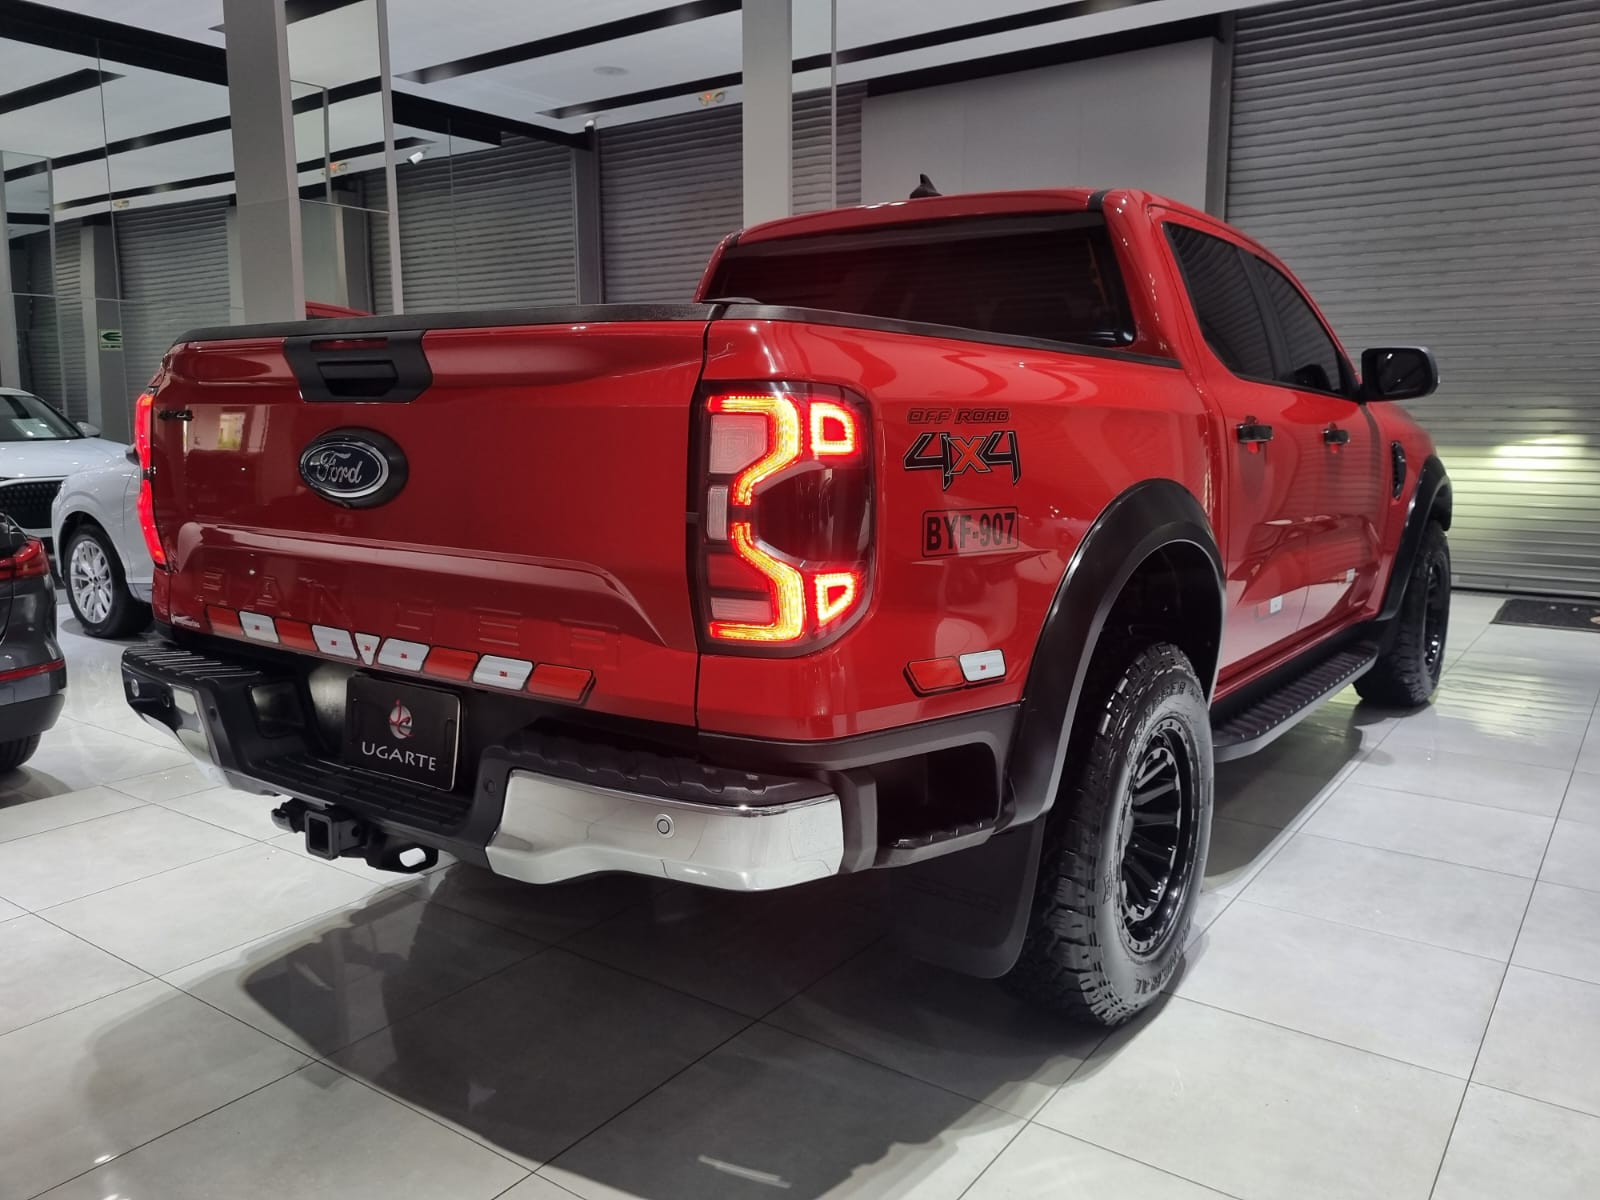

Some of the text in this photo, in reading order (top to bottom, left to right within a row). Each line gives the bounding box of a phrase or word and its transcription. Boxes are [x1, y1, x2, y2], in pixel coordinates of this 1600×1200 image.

[907, 408, 1010, 424] OFF ROAD
[309, 450, 363, 483] Ford
[926, 512, 1016, 551] BYF-907
[361, 741, 437, 772] UGARTE
